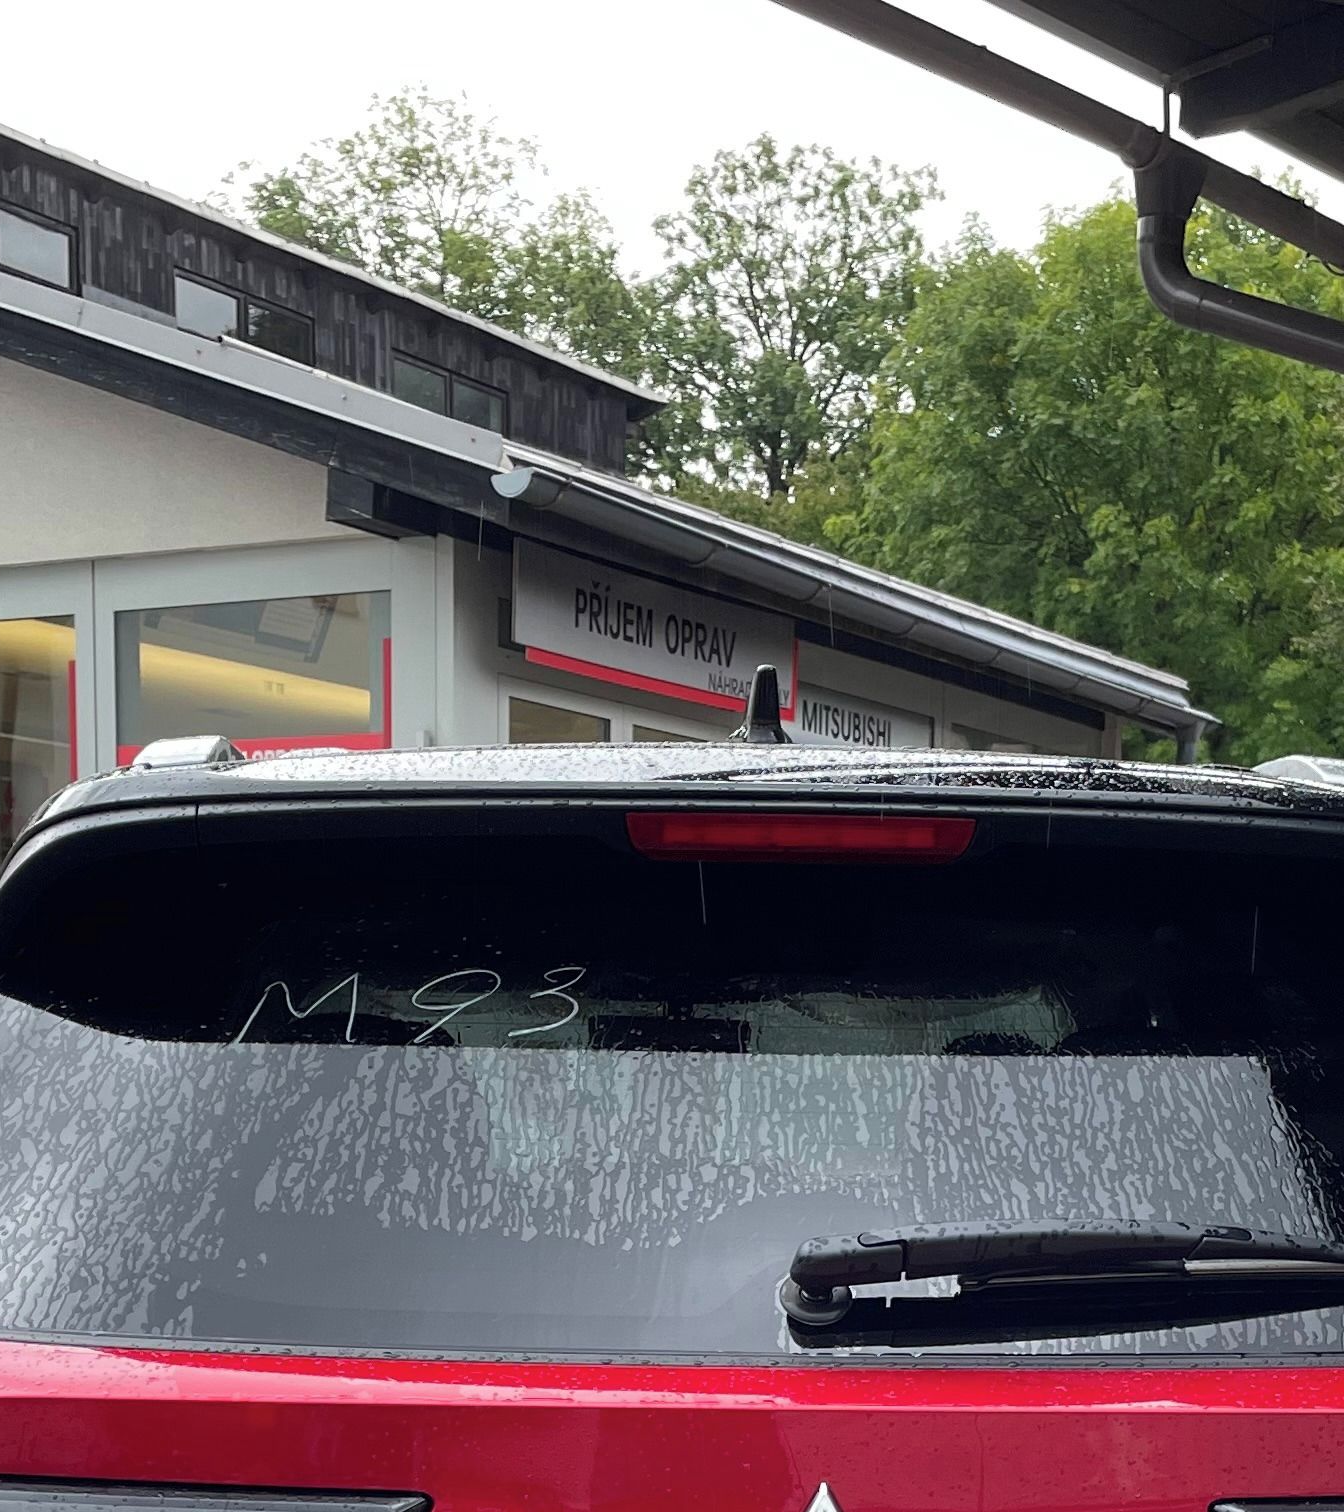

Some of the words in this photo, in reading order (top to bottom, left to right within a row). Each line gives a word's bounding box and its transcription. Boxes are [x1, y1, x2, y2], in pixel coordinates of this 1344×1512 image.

[574, 579, 654, 649] PŘÍJEM
[665, 613, 737, 668] OPRAV
[707, 670, 753, 701] NÁHRAD
[802, 699, 892, 748] MITSUBISHI
